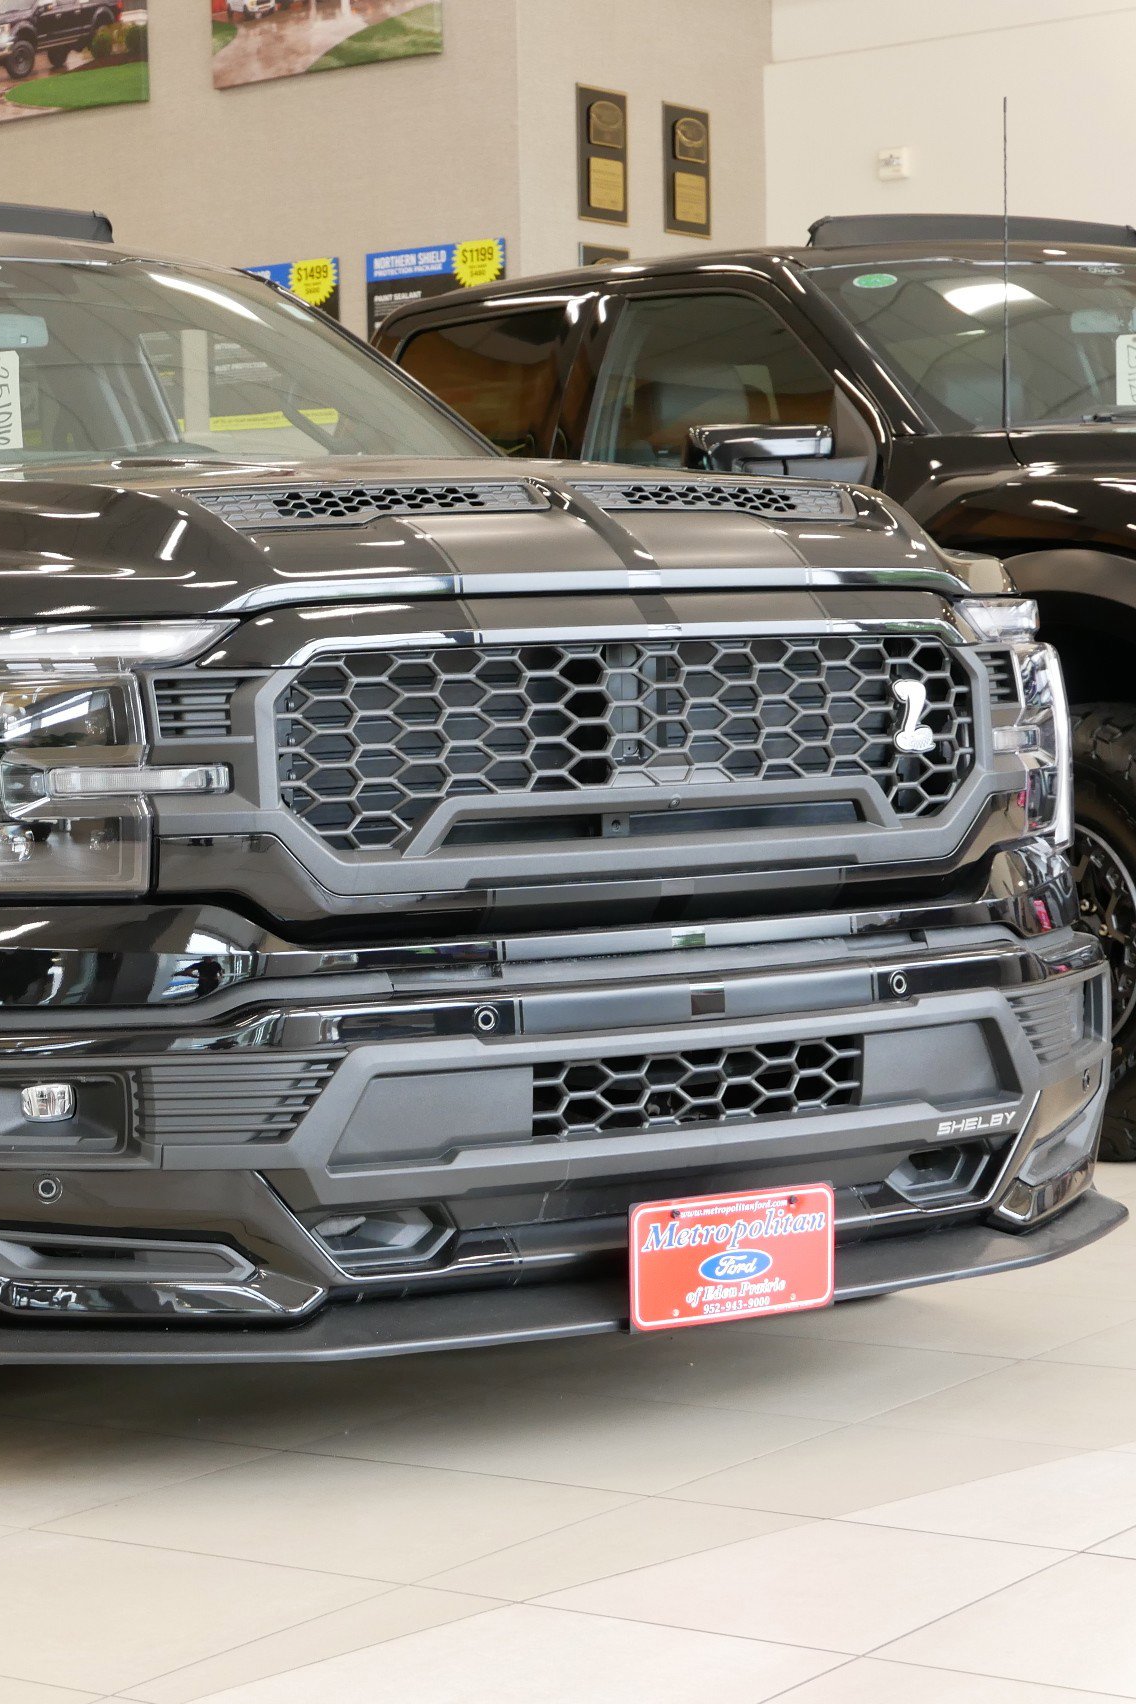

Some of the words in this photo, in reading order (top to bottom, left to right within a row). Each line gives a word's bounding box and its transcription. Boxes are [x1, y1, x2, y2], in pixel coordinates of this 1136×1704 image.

[373, 253, 416, 271] NORTHERN
[417, 249, 447, 266] SHIELD
[461, 245, 494, 264] $1199
[297, 264, 329, 282] $1499
[936, 1111, 1016, 1136] SHELBY
[680, 1199, 788, 1218] www.metropolitanford.com
[641, 1208, 826, 1251] Metropolitan
[714, 1255, 758, 1277] Ford
[685, 1286, 703, 1307] of
[702, 1284, 737, 1302] Eden
[738, 1277, 786, 1297] Prairie
[703, 1296, 771, 1315] 952-943-9000
